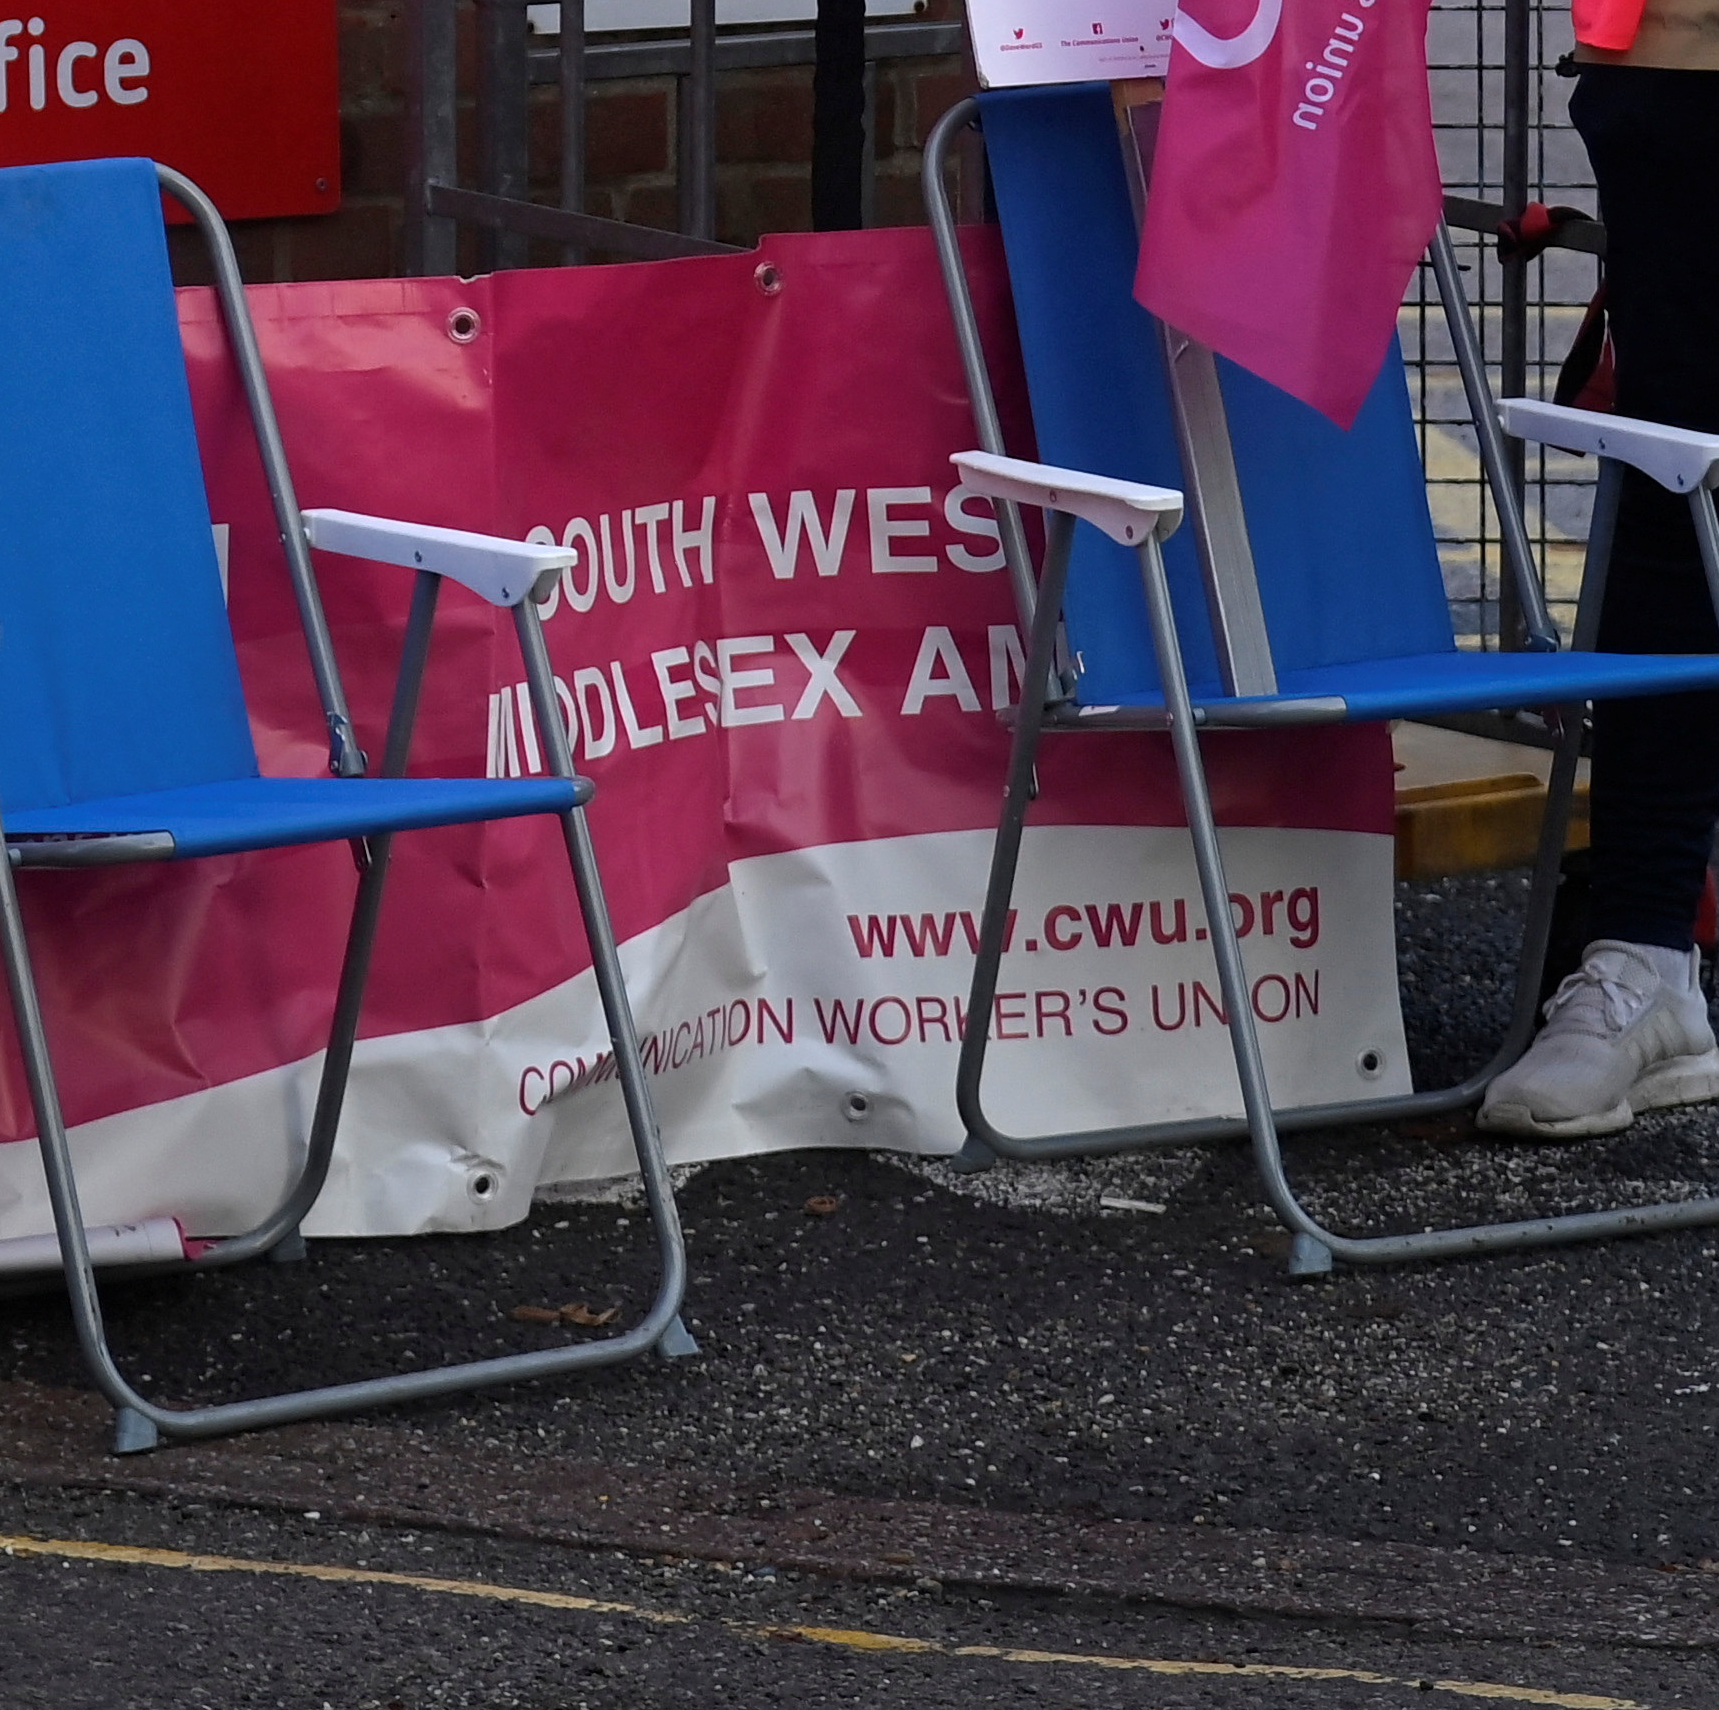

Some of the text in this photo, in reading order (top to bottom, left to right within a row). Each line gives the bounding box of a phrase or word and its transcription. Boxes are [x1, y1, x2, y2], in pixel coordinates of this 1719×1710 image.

[748, 484, 1008, 579] WES
[846, 886, 1321, 960] www.cwu.org
[519, 969, 1321, 1116] COMMNICATION WORKER'S UNON
